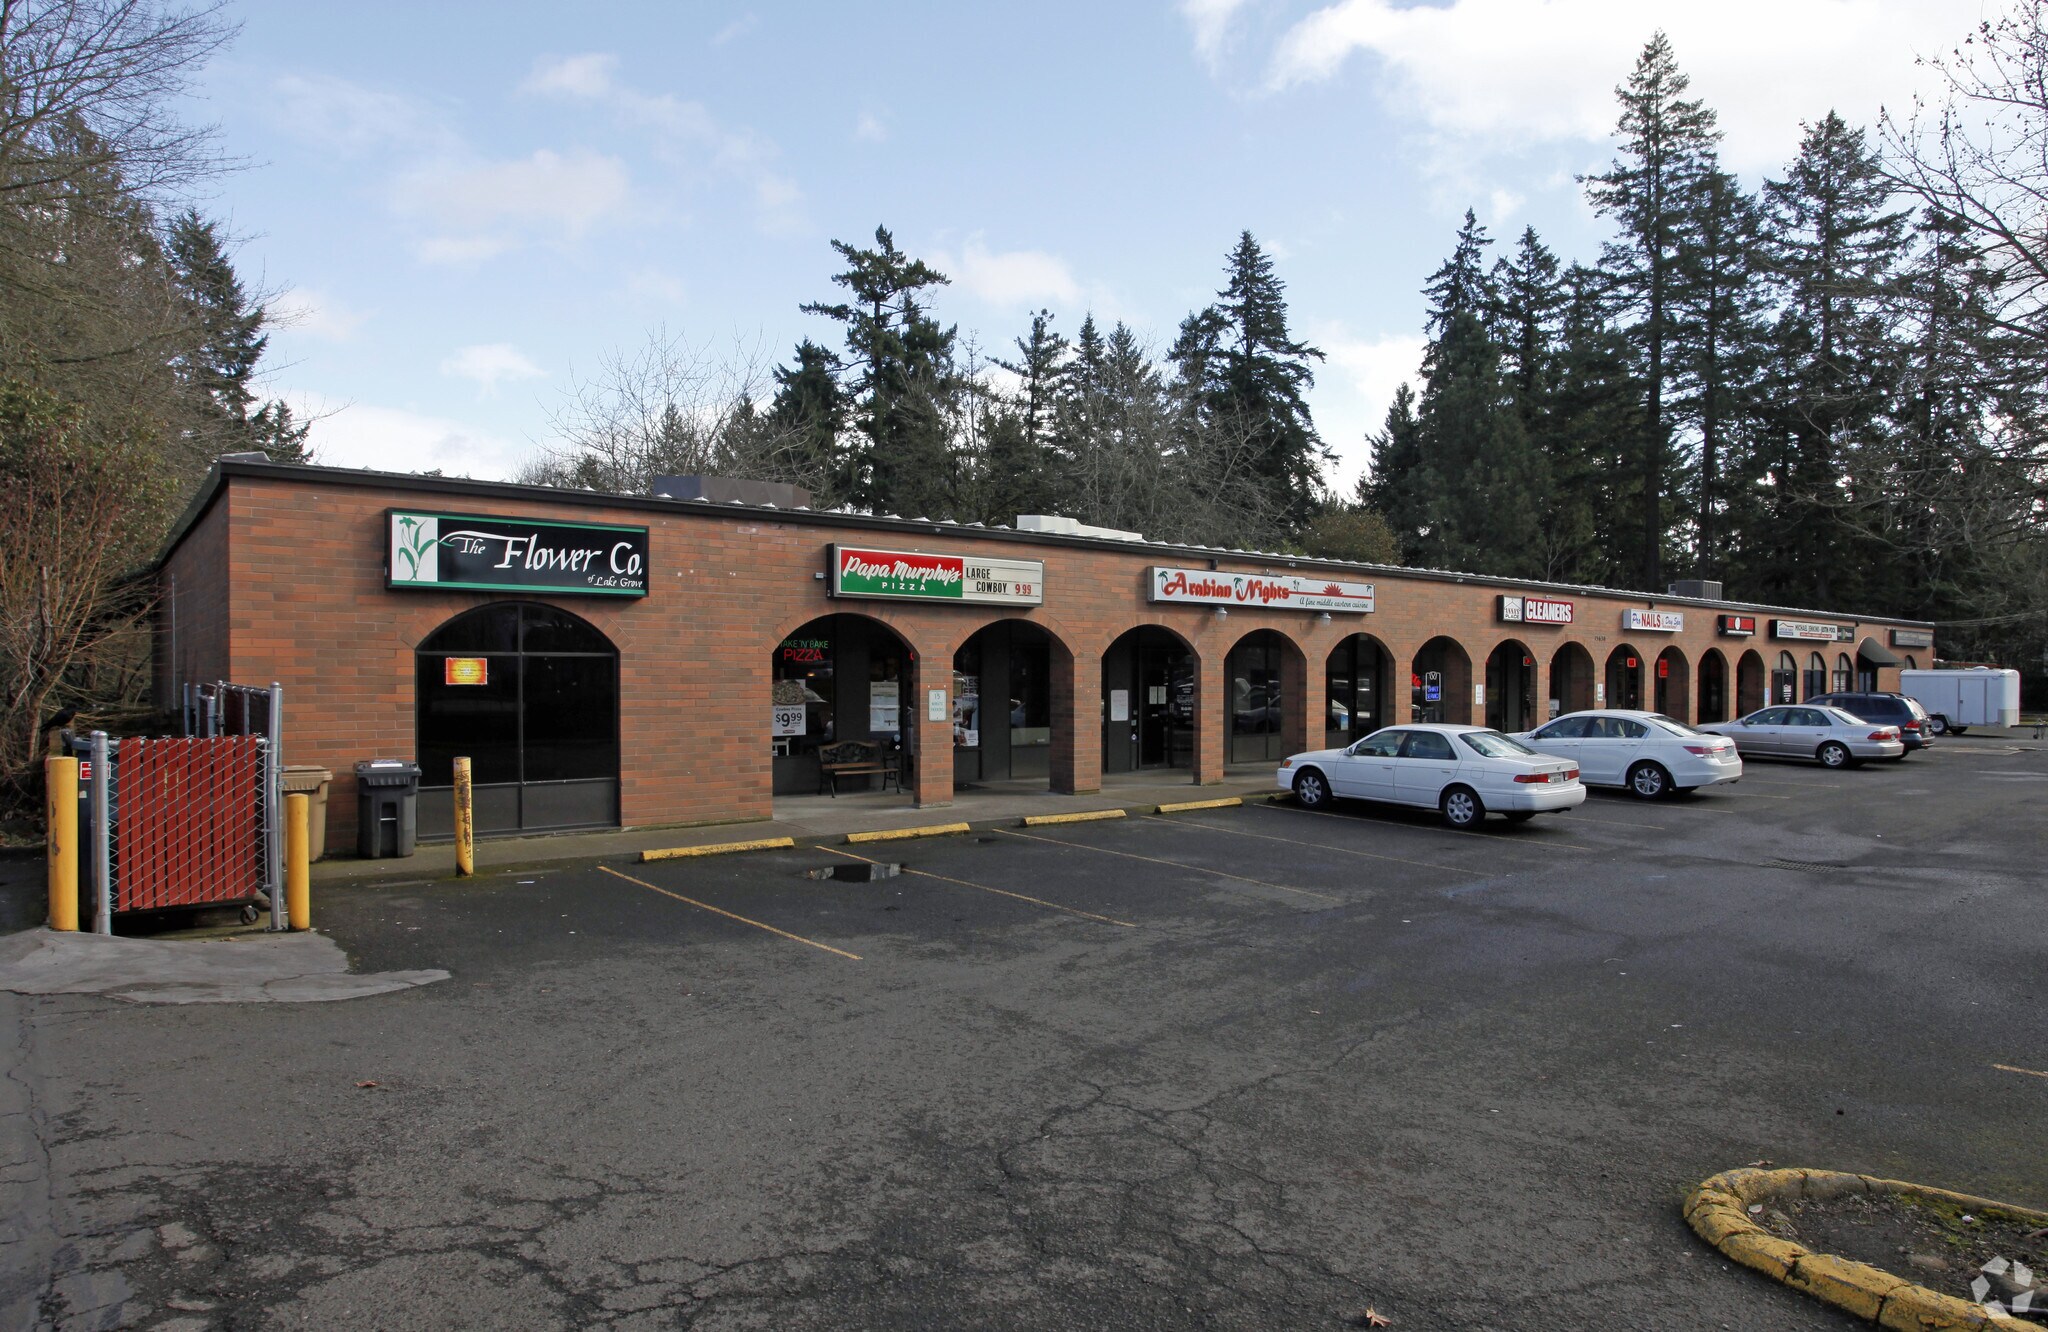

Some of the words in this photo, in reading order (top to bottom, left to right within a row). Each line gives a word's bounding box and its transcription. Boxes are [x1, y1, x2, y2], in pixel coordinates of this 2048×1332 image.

[450, 536, 486, 555] The
[494, 534, 603, 572] Flower
[610, 542, 643, 576] Co.
[842, 555, 891, 582] Papa
[891, 560, 962, 587] Murphy's
[966, 567, 991, 580] LARGE
[588, 575, 595, 584] of
[594, 575, 618, 588] Lake
[620, 577, 643, 588] Grove
[882, 581, 927, 592] PIZZA
[976, 581, 1008, 594] COWBOY
[1163, 572, 1232, 599] Arabian
[1236, 579, 1290, 605] Nights
[1316, 598, 1334, 607] middle
[1526, 599, 1572, 622] CLEANERS
[1641, 612, 1661, 628] NAILS
[810, 640, 829, 649] BAKE
[783, 648, 824, 662] PIZZA
